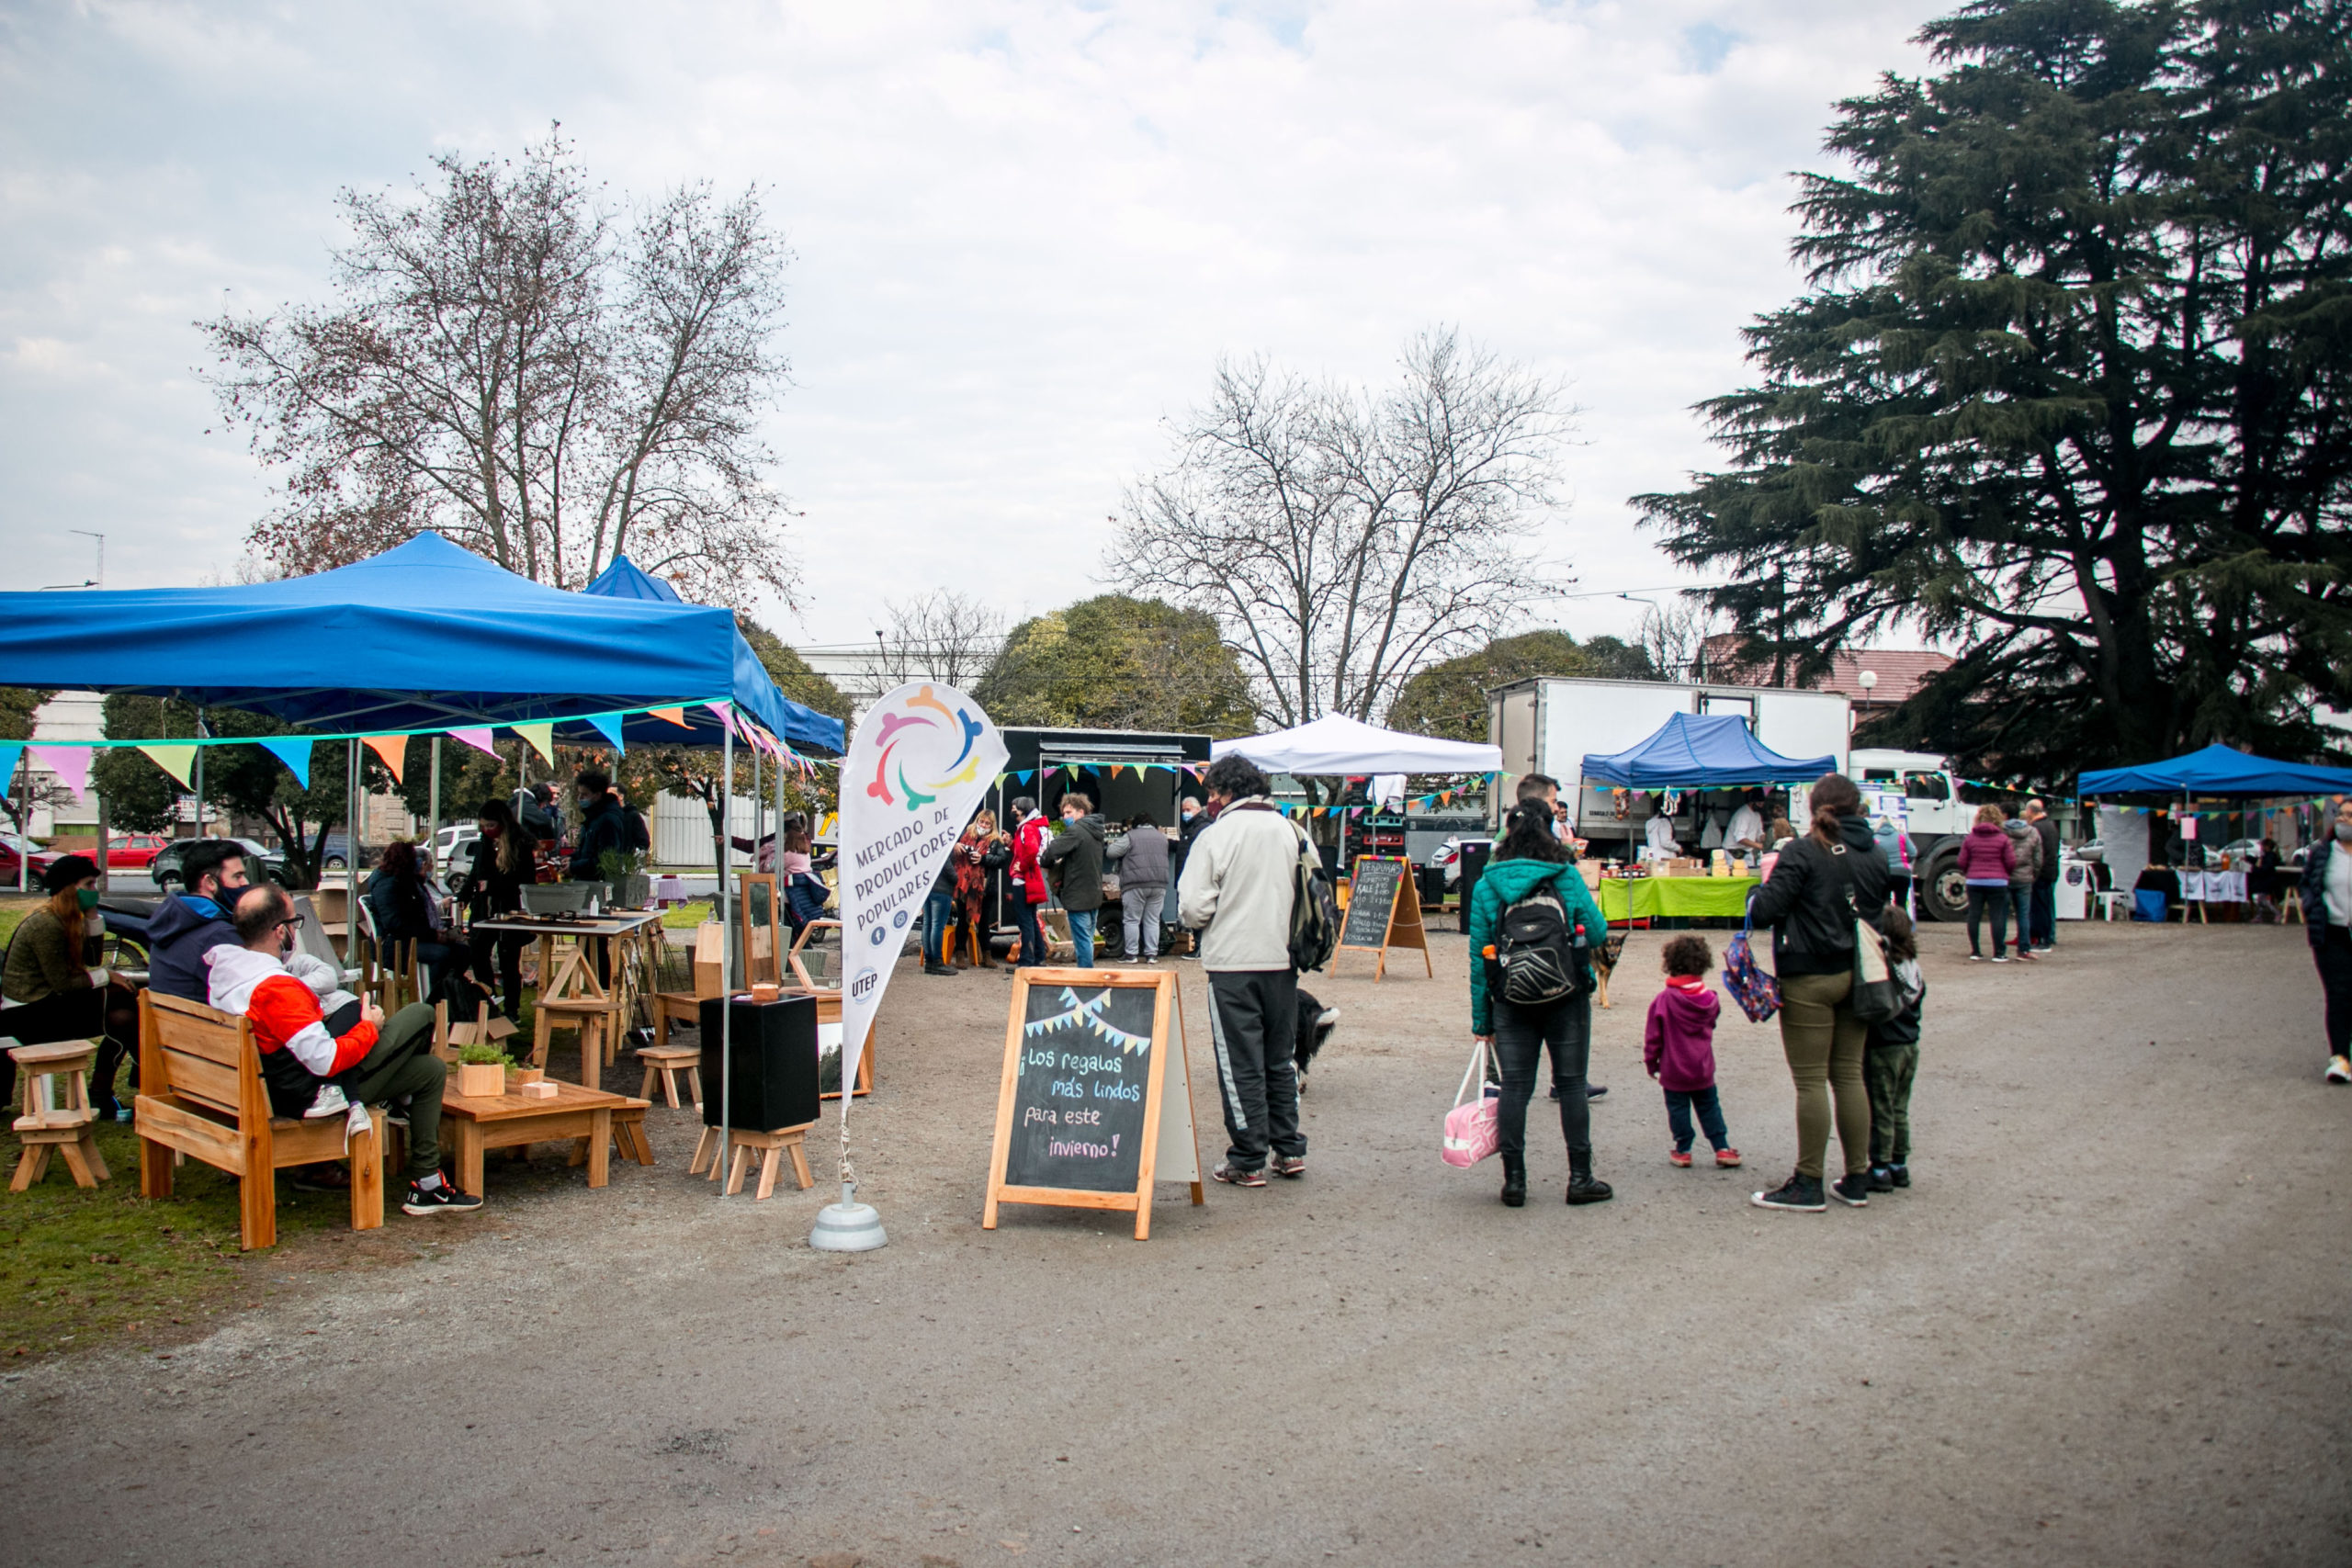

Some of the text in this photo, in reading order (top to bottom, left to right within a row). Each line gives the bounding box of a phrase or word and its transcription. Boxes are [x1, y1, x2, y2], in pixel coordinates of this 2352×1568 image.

[855, 807, 949, 869] MERCADO DE
[854, 827, 956, 900] PRODUCTORES
[856, 870, 930, 931] POPULARES
[1356, 884, 1374, 895] KALE
[852, 973, 877, 998] UTEP
[1061, 1052, 1122, 1076] regalos
[1051, 1077, 1140, 1101] más lindos
[1023, 1106, 1101, 1128] para este
[1048, 1134, 1120, 1158] invierno!
